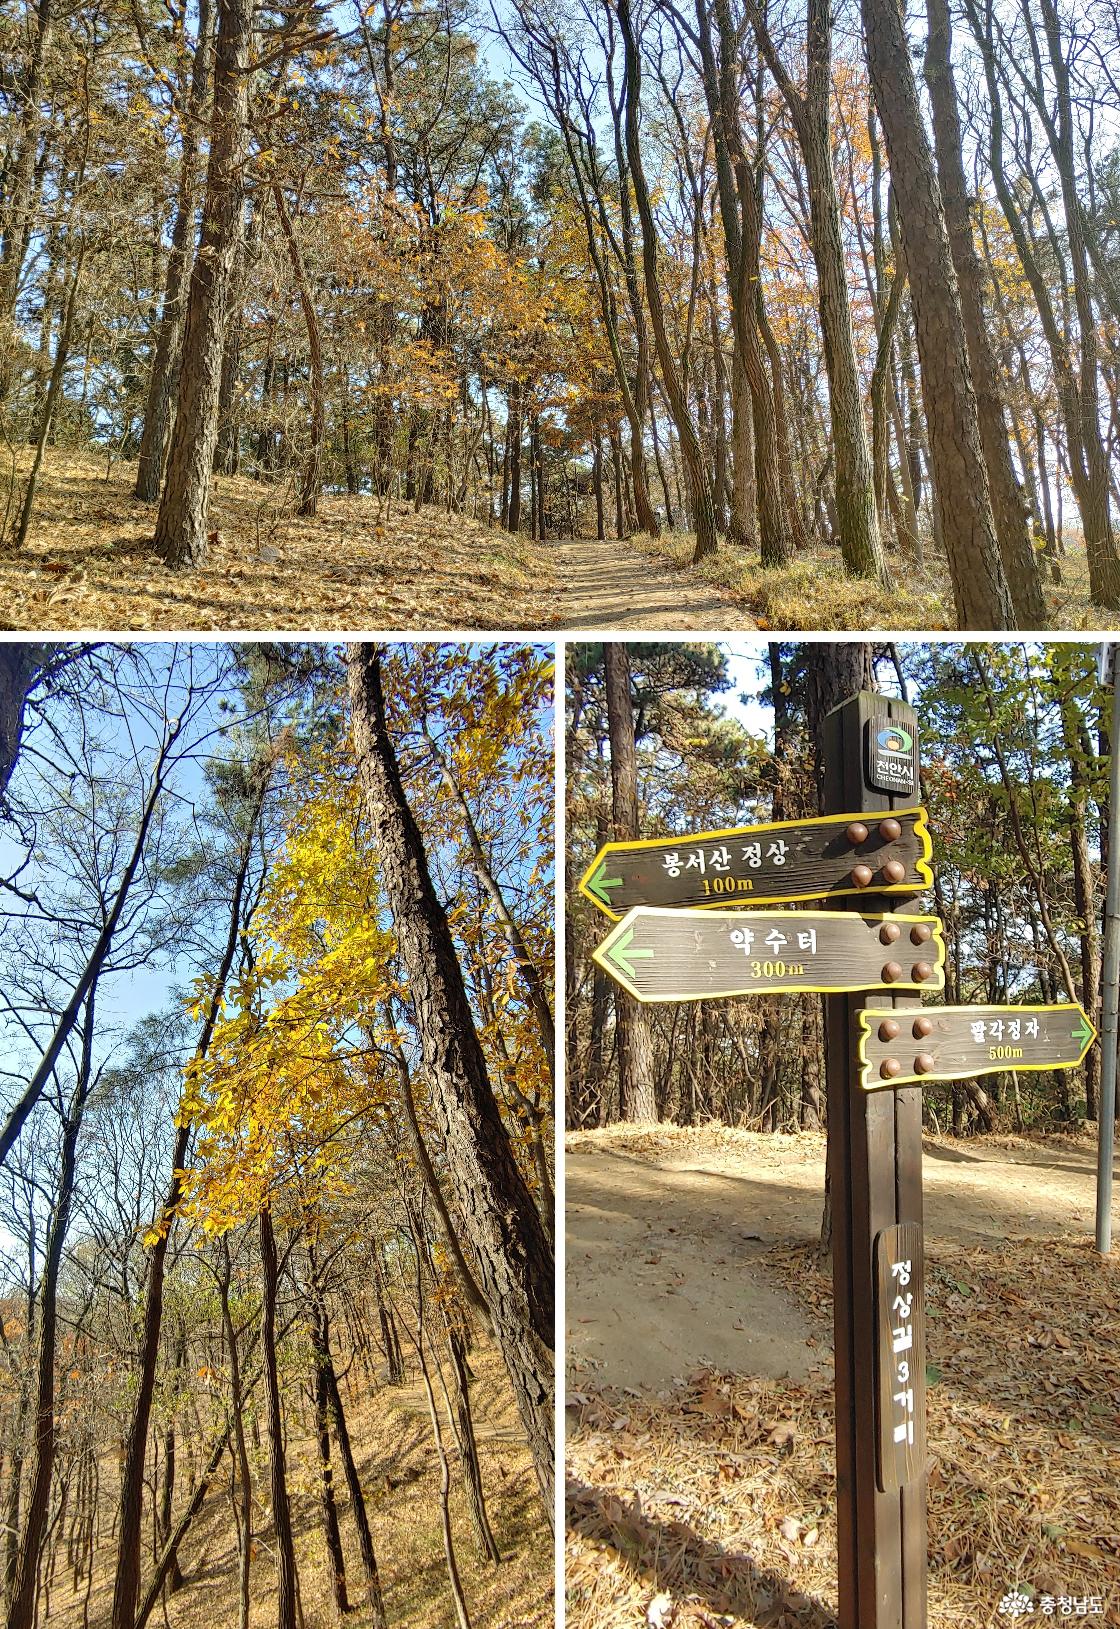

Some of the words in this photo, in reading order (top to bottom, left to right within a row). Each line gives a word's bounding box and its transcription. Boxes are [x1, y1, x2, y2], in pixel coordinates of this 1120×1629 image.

[876, 760, 914, 780] 천안시
[661, 846, 732, 878] 봉서산
[741, 840, 790, 868] 정상
[702, 876, 754, 896] 100m
[730, 927, 817, 956] 약수터
[750, 961, 805, 978] 300m
[970, 1017, 1040, 1043] 팔각정자
[989, 1045, 1023, 1060] 500m
